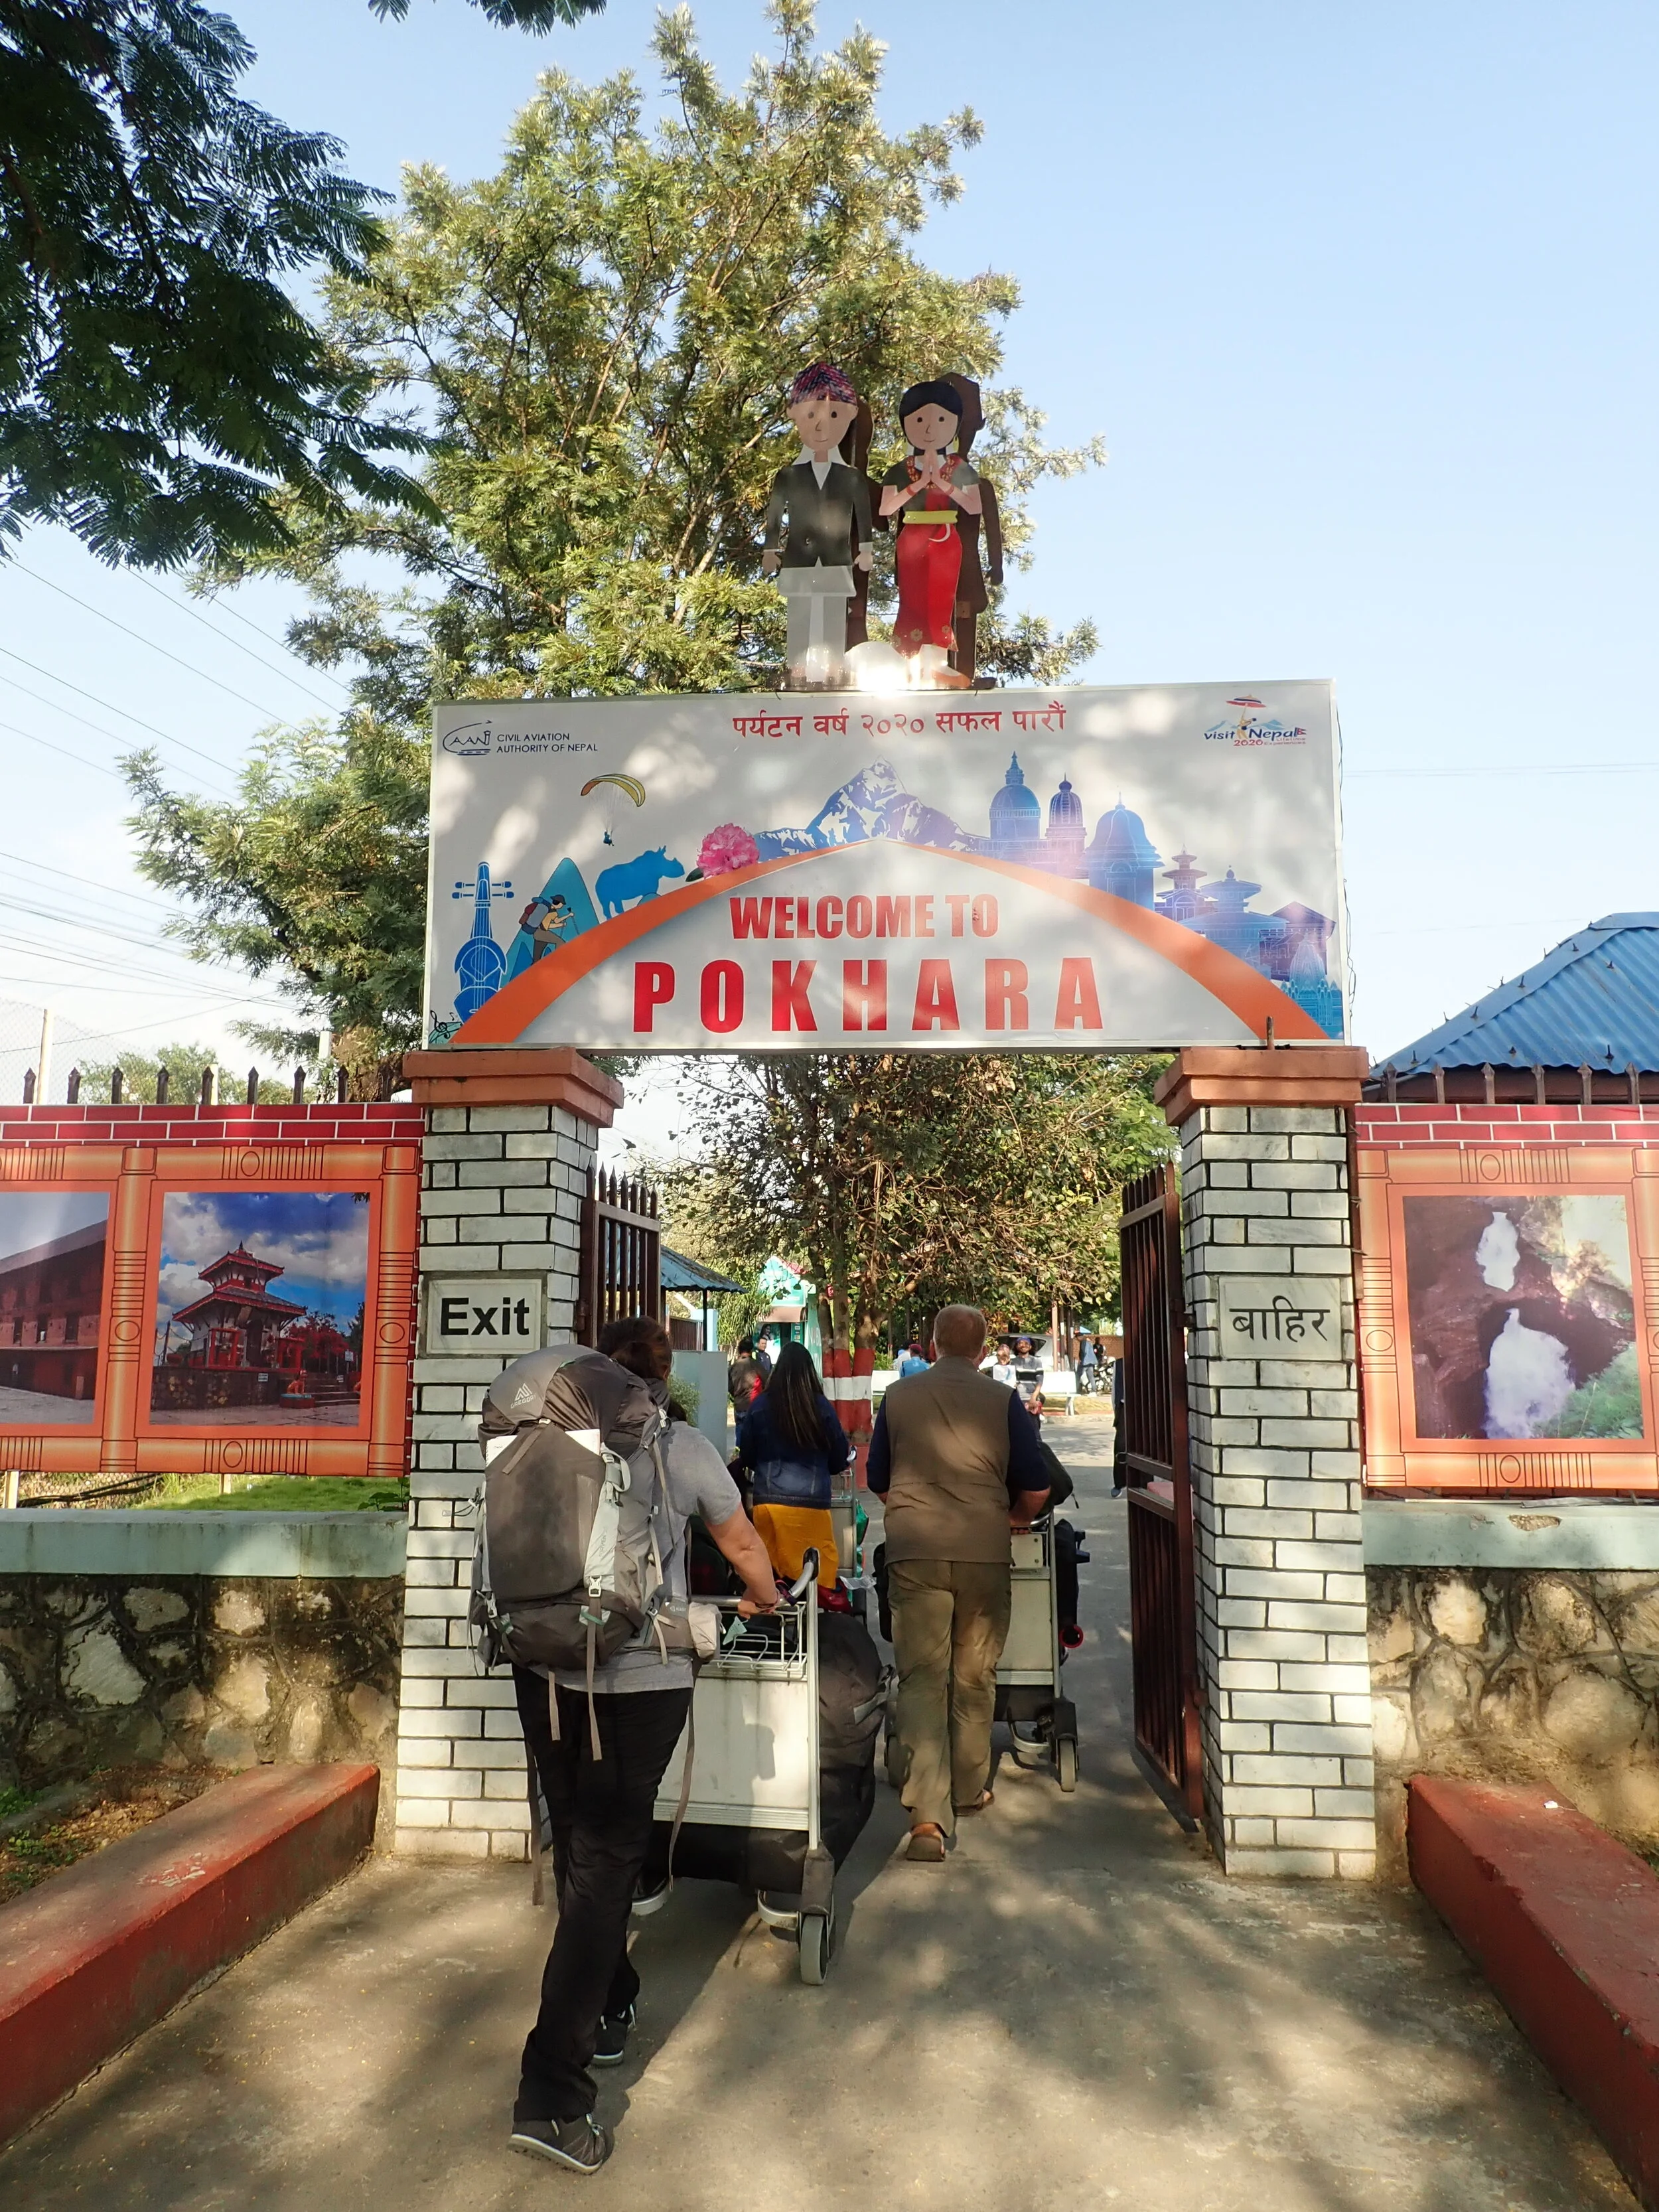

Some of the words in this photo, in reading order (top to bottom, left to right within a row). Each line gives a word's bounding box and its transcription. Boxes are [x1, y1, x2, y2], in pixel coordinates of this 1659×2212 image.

[497, 733, 521, 742] CIVIL
[524, 733, 570, 741] AVIATION
[732, 709, 803, 738] पर्यटन
[813, 707, 849, 736] वर्ष
[861, 713, 924, 737] २०२०
[935, 711, 1002, 733] सफल
[1012, 700, 1066, 732] पारौं
[1204, 730, 1235, 740] visit
[1248, 727, 1298, 741] Nepal
[496, 745, 548, 753] AUTHORITY
[567, 743, 598, 752] NEPAL
[730, 894, 934, 940] WELCOME
[946, 894, 999, 938] TO
[632, 956, 1104, 1034] POKHARA
[441, 1297, 530, 1336] Exit
[1229, 1295, 1331, 1343] बाहिर
[510, 1395, 537, 1409] GREGORY
